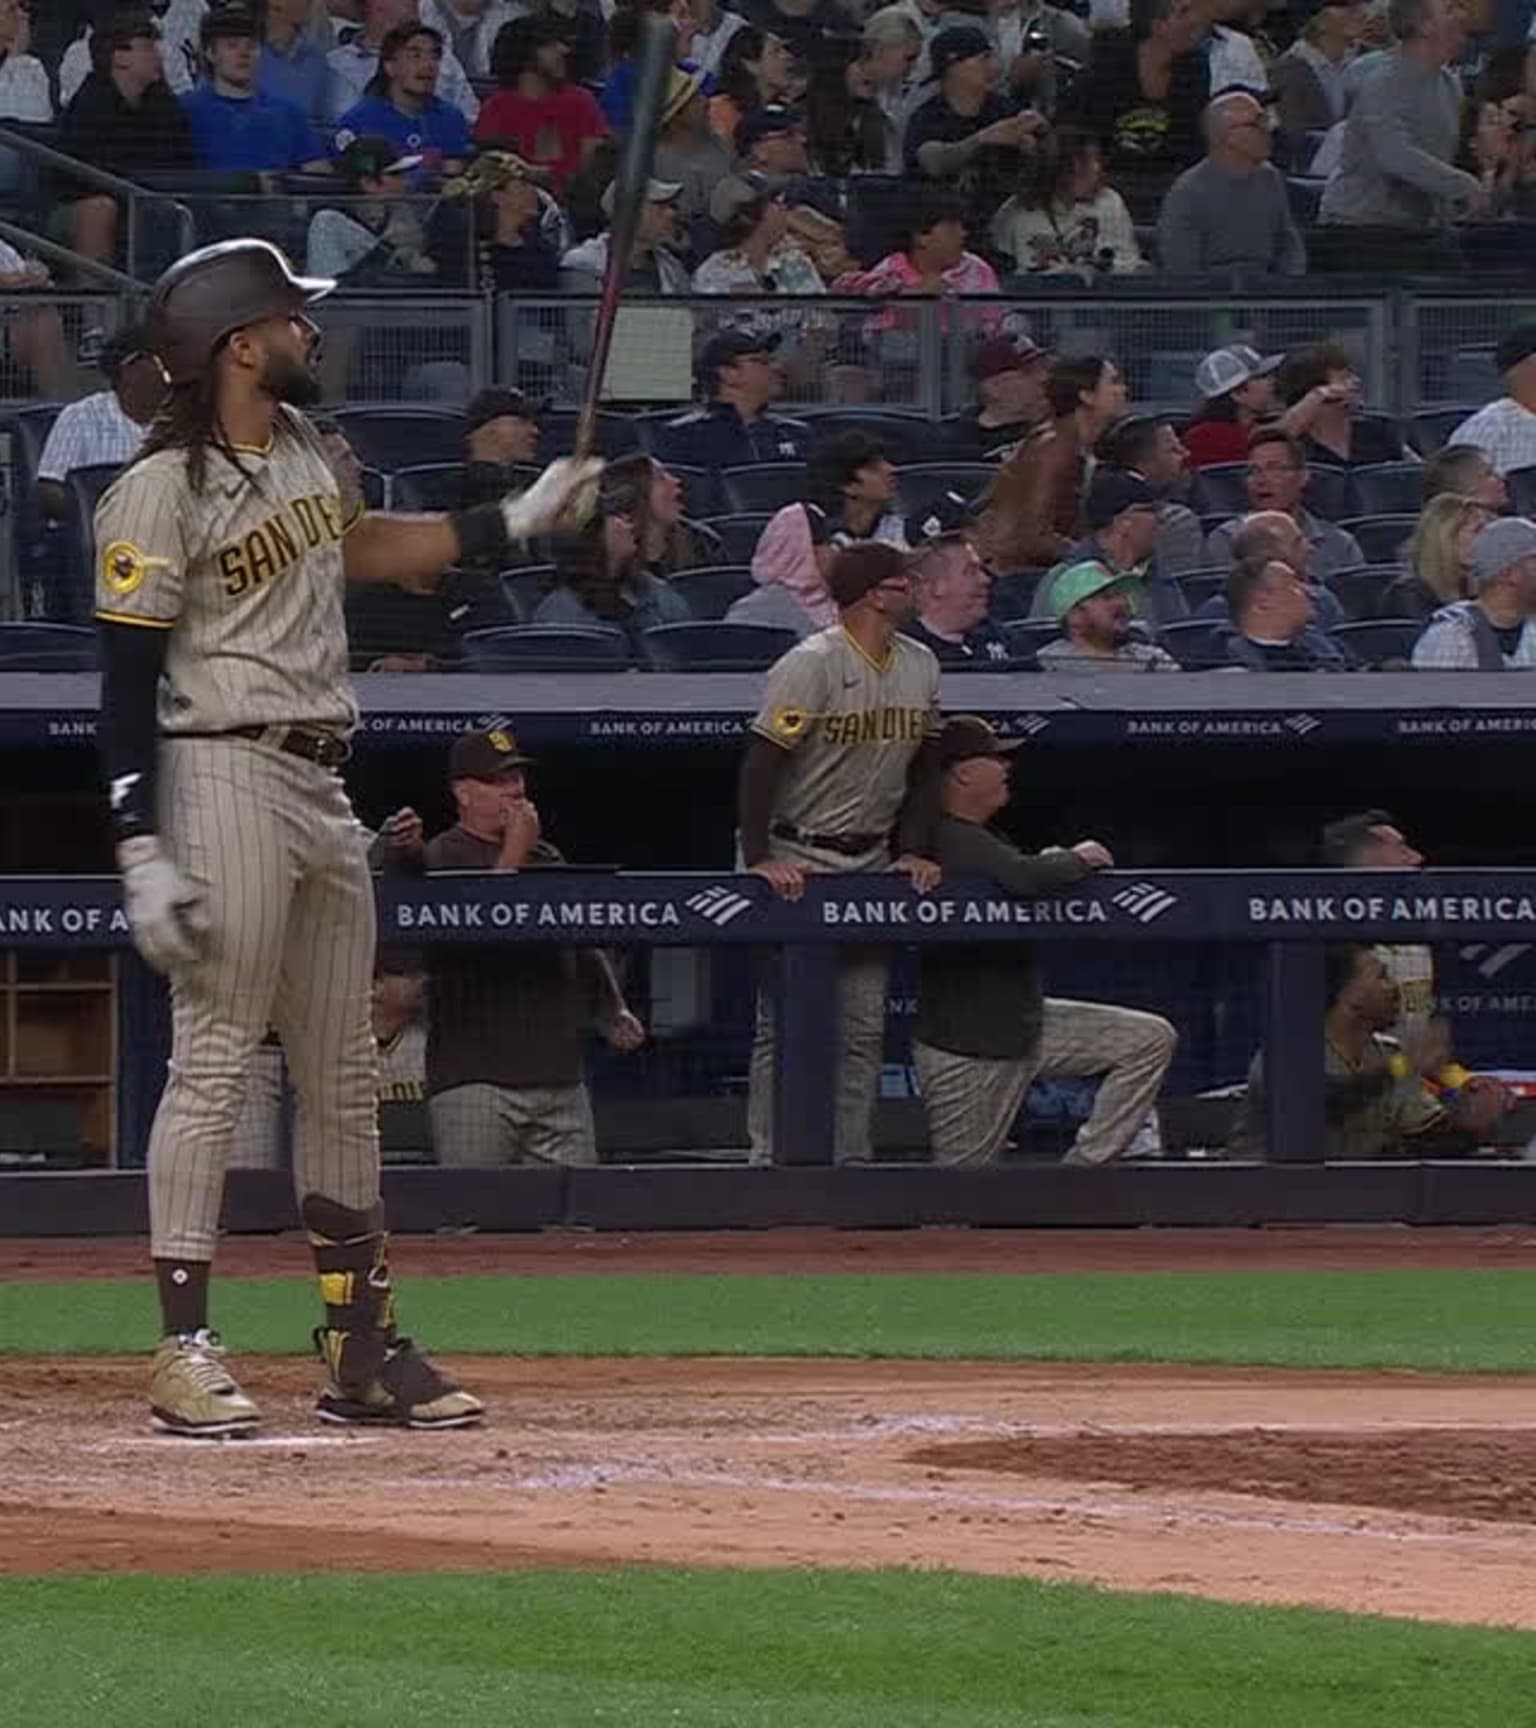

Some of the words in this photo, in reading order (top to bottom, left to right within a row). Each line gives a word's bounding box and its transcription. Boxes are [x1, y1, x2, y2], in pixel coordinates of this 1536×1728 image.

[219, 515, 298, 596] SAN
[48, 721, 97, 735] BANK
[369, 718, 393, 731] OF
[396, 718, 474, 733] AMERICA
[590, 721, 637, 735] BANK
[639, 721, 662, 735] OF
[666, 720, 744, 735] AMERICA
[823, 709, 879, 745] SAN
[1127, 721, 1175, 734] BANK
[1177, 721, 1201, 734] OF
[1203, 721, 1282, 734] AMERICA
[1398, 719, 1447, 733] BANK
[1448, 718, 1472, 733] OF
[397, 904, 483, 926] BANK
[491, 903, 530, 926] OF
[538, 902, 680, 925] AMERICA
[823, 901, 909, 923] BANK
[916, 900, 955, 923] OF
[963, 900, 1107, 923] AMERICA
[1249, 898, 1336, 920] BANK
[1343, 898, 1384, 920] OF
[1391, 897, 1536, 920] AMERICA
[61, 909, 102, 932] OF
